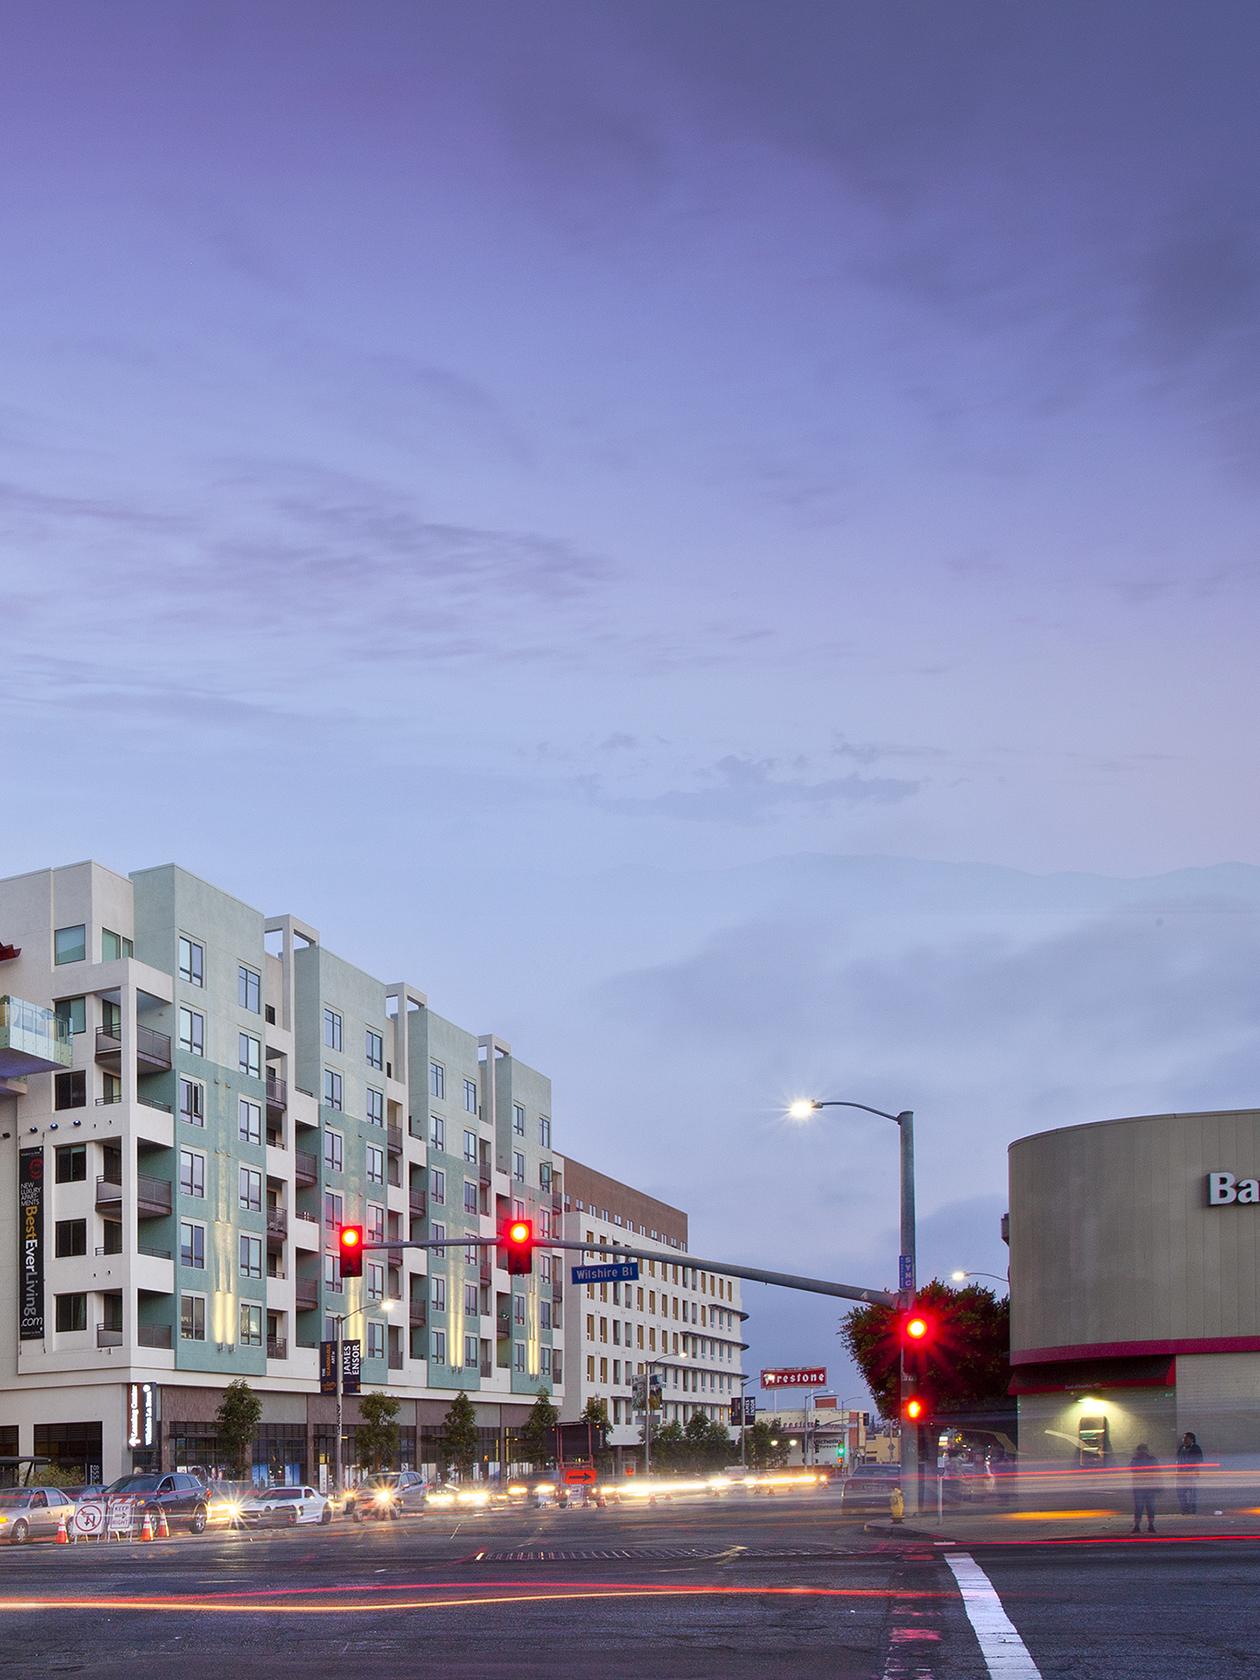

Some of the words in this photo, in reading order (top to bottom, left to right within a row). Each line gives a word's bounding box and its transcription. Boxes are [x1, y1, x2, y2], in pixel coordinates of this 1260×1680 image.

[576, 1268, 618, 1280] Wilshire
[622, 1266, 633, 1277] Bl
[343, 1345, 351, 1375] JAMES
[352, 1344, 360, 1375] ENSOR
